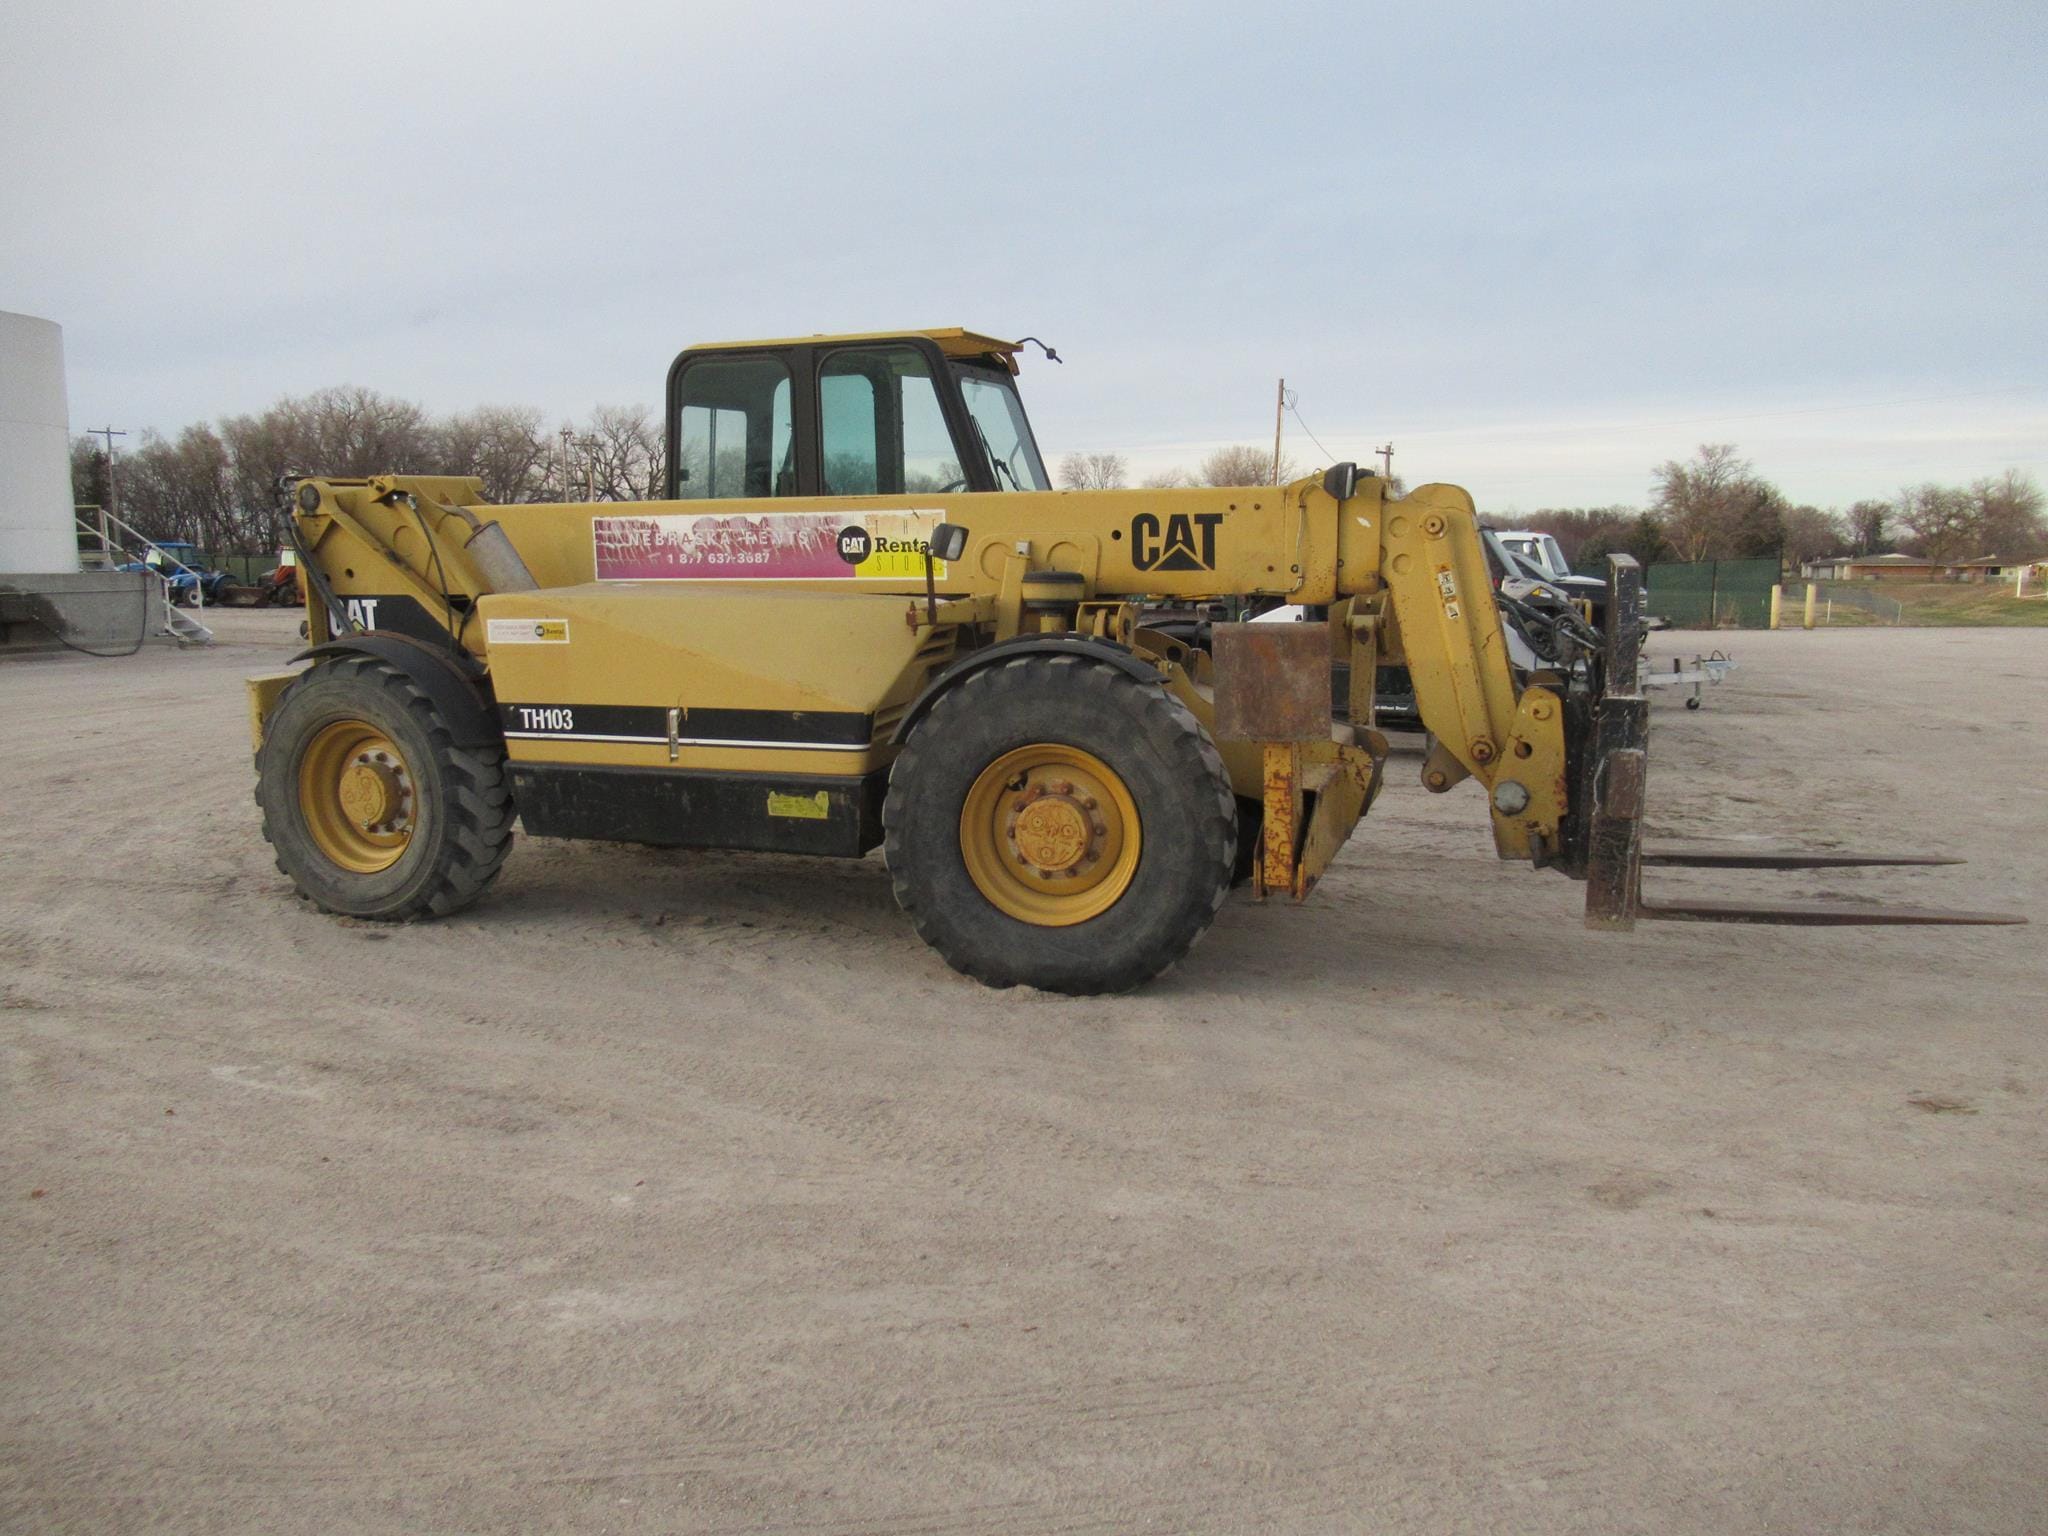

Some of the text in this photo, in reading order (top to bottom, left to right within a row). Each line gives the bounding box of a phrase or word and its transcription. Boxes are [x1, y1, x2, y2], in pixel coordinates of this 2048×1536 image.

[629, 531, 730, 546] NEBRASKA
[842, 538, 865, 553] CAT
[875, 537, 930, 554] Renta
[1132, 513, 1223, 571] CAT
[668, 554, 673, 564] 1
[520, 708, 573, 730] TH103
